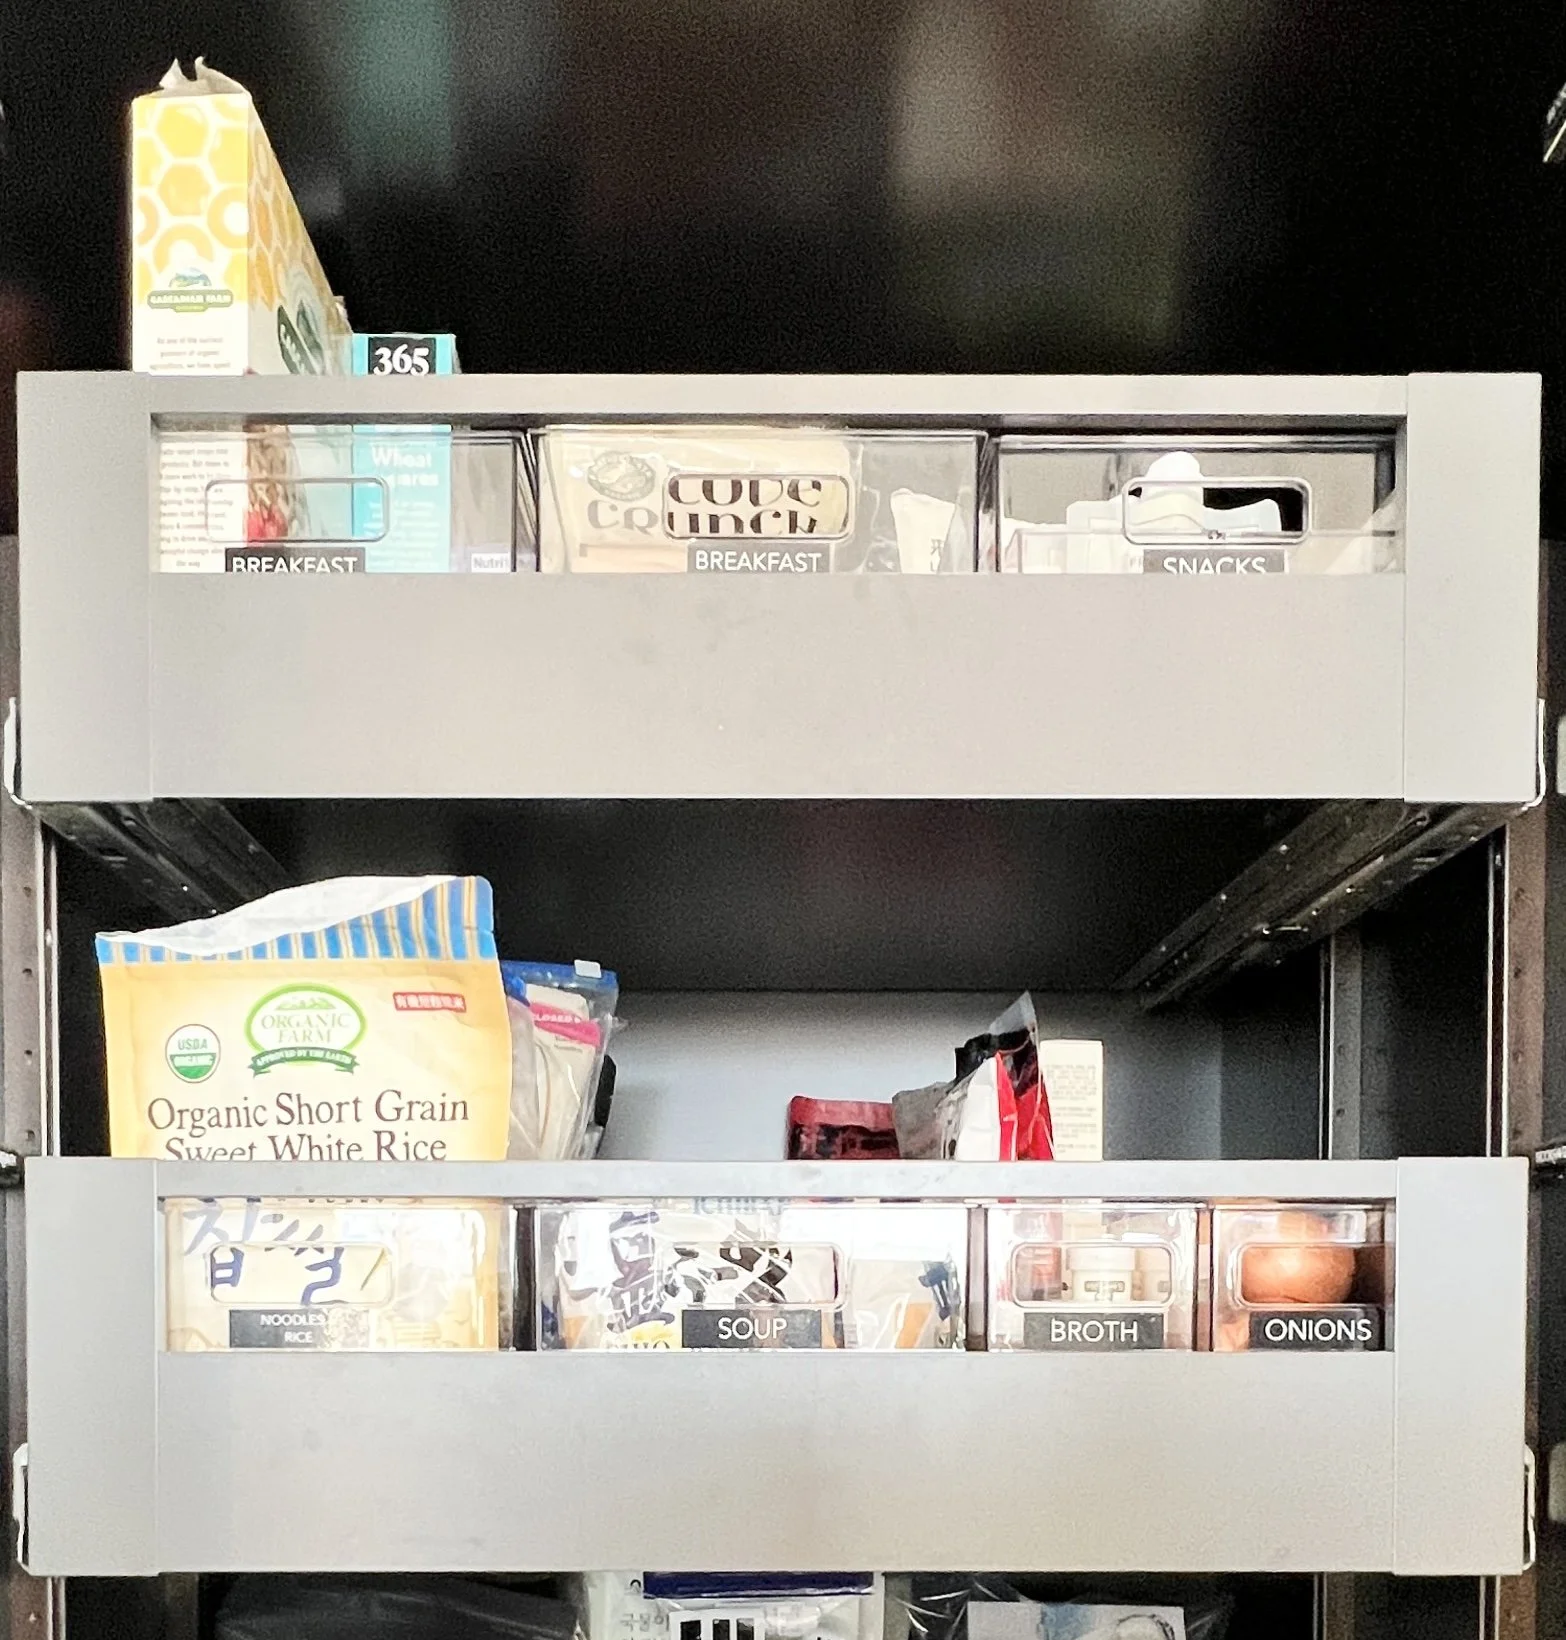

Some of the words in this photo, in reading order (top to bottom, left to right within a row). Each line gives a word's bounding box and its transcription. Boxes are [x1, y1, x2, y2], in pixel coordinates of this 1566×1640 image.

[373, 344, 430, 376] 365
[231, 556, 358, 573] BREAKFAST
[695, 551, 822, 573] BREAKFAST
[1163, 556, 1267, 575] SNACKS
[260, 1013, 350, 1030] ORGANIC
[177, 1039, 208, 1051] USDA
[277, 1029, 333, 1044] FARM
[147, 1096, 268, 1138] Organic
[275, 1092, 363, 1126] Short
[374, 1089, 470, 1123] Grain
[165, 1137, 257, 1160] Sweet
[268, 1133, 364, 1160] White
[373, 1130, 447, 1160] Rice
[260, 1314, 326, 1326] NOODLES
[717, 1318, 787, 1340] SOUP
[1264, 1318, 1373, 1342] ONIONS
[284, 1331, 313, 1344] RICE
[1050, 1318, 1138, 1343] BROTH
